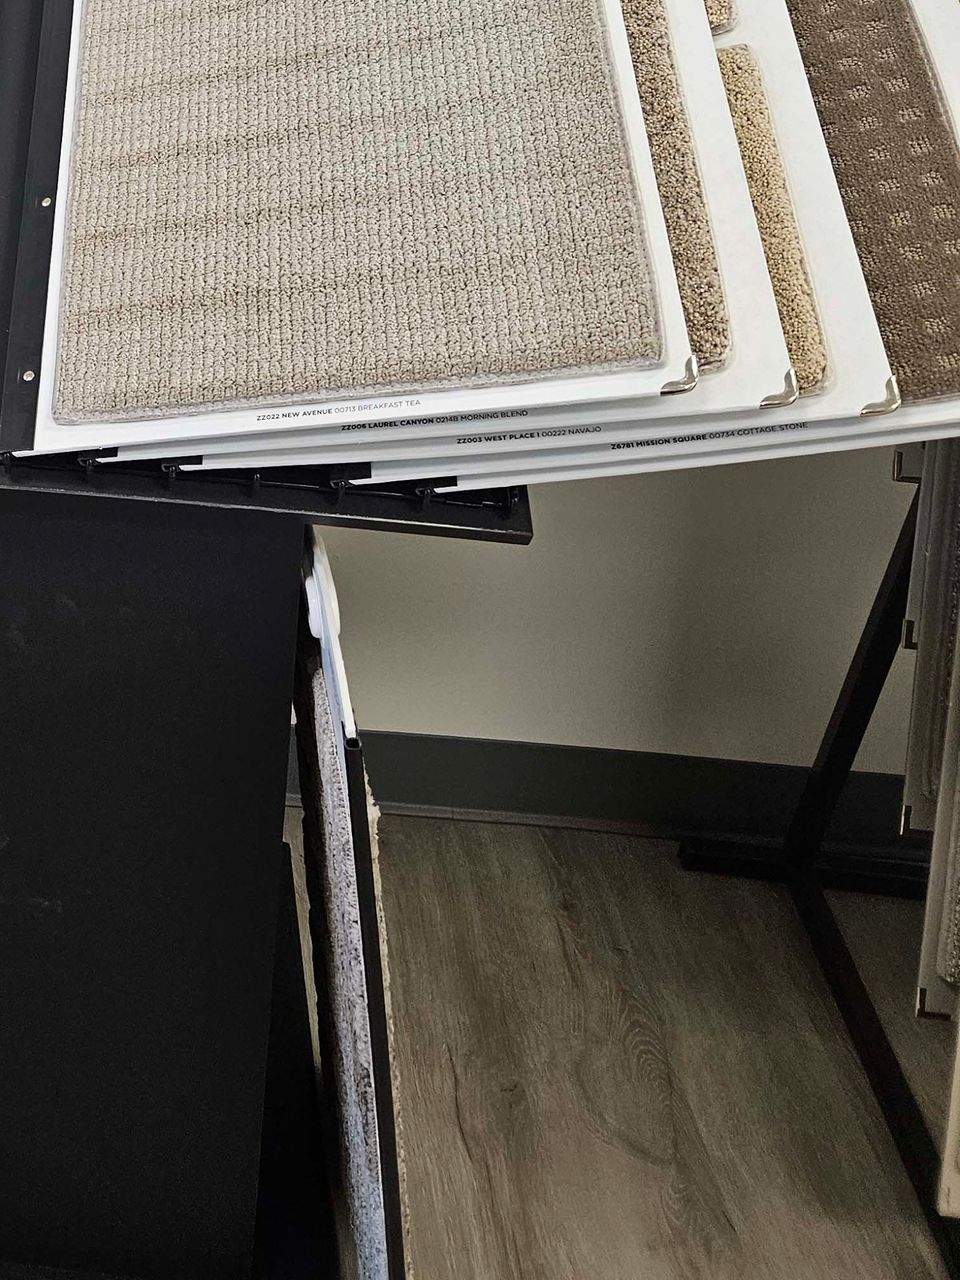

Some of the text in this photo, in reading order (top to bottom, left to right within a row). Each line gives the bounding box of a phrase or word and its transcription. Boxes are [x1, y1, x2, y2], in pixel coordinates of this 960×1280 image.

[256, 399, 421, 421] ZZ022 NEW AVENUE 00713 BREAKFAST TEA
[341, 423, 367, 431] ZZ006
[368, 421, 399, 430] LAUREL
[400, 417, 435, 427] CANYON
[460, 411, 500, 422] MORNING
[501, 410, 529, 418] BLEND
[457, 437, 483, 445] ZZ003
[484, 434, 508, 442] WEST
[509, 432, 536, 441] PLACE
[541, 429, 567, 437] 00222
[568, 426, 602, 435] NAVAJO
[611, 442, 635, 450] Z6781
[636, 438, 671, 448] MISSION
[672, 433, 708, 443] SQUARE
[736, 425, 778, 436] COTTAGE
[779, 422, 809, 431] STONE
